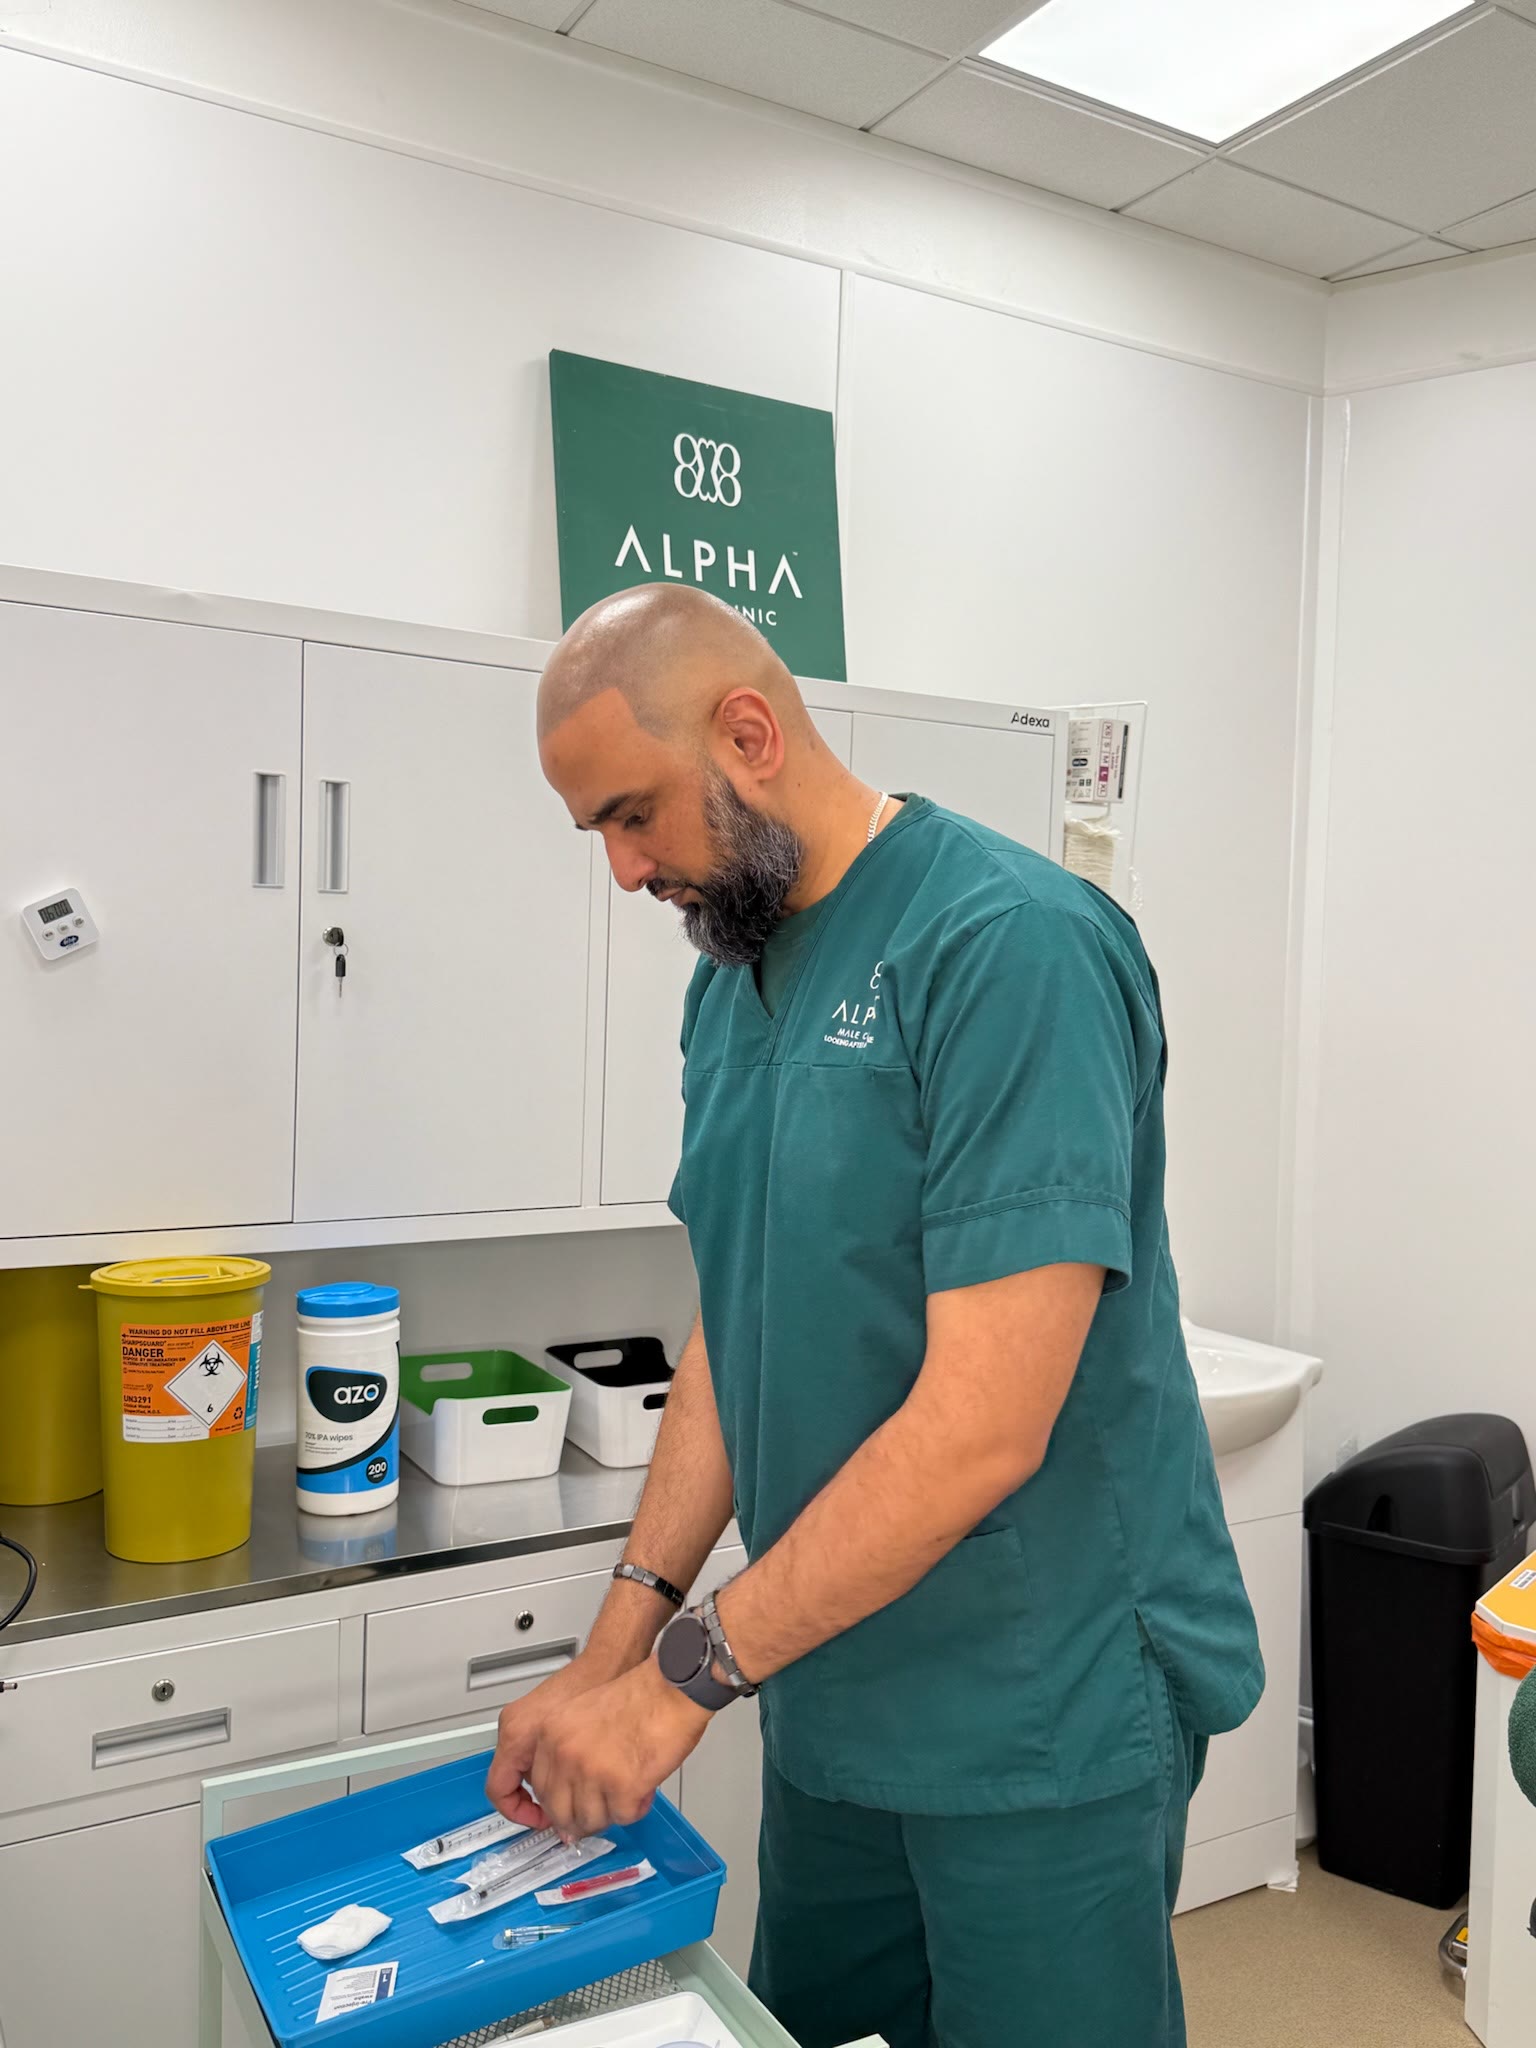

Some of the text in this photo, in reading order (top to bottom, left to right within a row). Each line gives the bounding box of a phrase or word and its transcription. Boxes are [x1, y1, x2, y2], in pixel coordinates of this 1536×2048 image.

[615, 524, 803, 599] ALPHA
[734, 604, 777, 626] NIC
[1011, 711, 1050, 728] Adexa
[832, 999, 876, 1026] ALP
[837, 1028, 861, 1040] MALE
[128, 1328, 160, 1336] WARNING
[162, 1328, 172, 1336] DO
[190, 1327, 204, 1335] FILL
[206, 1324, 227, 1333] ABOVE
[229, 1322, 240, 1331] THE
[240, 1320, 251, 1328] LINE
[122, 1346, 164, 1358] DANGER
[123, 1394, 151, 1404] UN3291
[333, 1384, 379, 1405] azo
[207, 1403, 214, 1413] 6
[317, 1433, 328, 1441] IPA
[330, 1433, 353, 1442] wipes
[368, 1461, 387, 1476] 200
